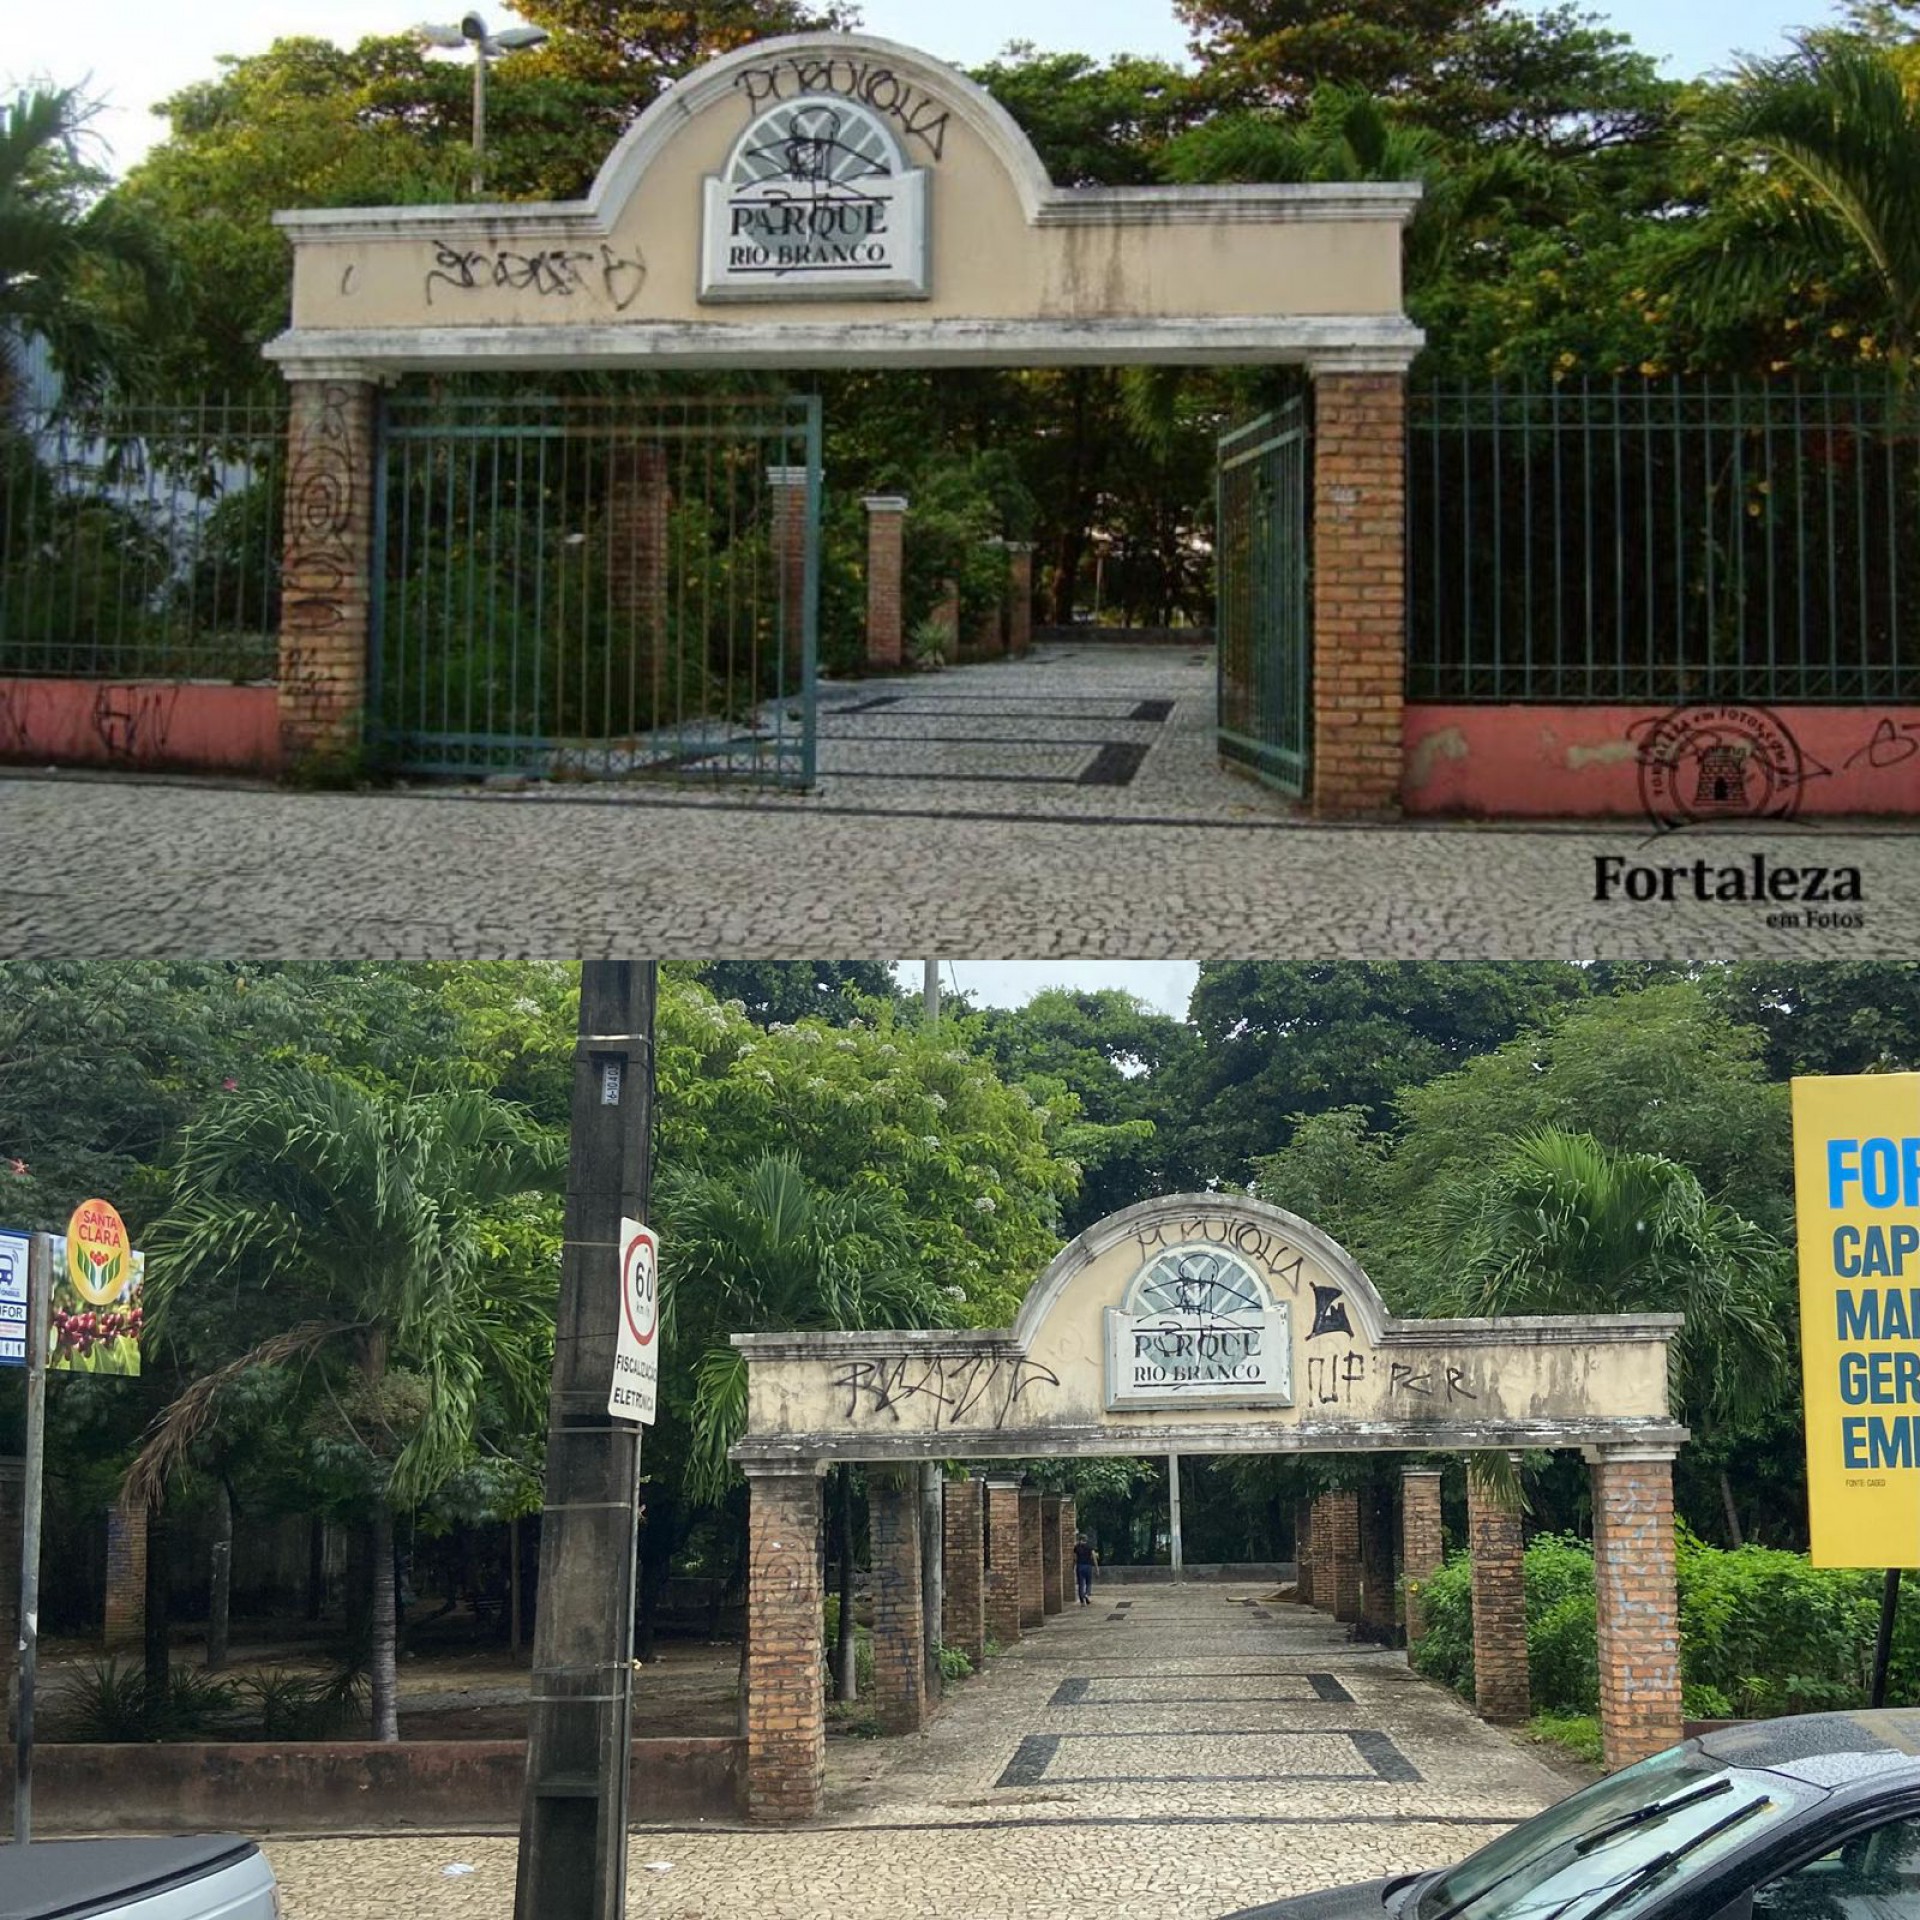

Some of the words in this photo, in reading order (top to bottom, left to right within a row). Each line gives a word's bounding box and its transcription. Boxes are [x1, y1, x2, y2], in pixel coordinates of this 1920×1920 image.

[731, 204, 888, 240] PARQUE
[730, 245, 769, 266] RIO
[778, 243, 884, 264] BRANCO
[83, 1210, 117, 1228] SANTA
[79, 1224, 120, 1248] CLARA
[1833, 1225, 1919, 1278] CAP
[636, 1262, 653, 1302] 60
[1134, 1333, 1261, 1361] PARQUE
[1134, 1367, 1166, 1381] RIO
[1173, 1364, 1260, 1381] BRANCO
[1839, 1352, 1920, 1405] GER
